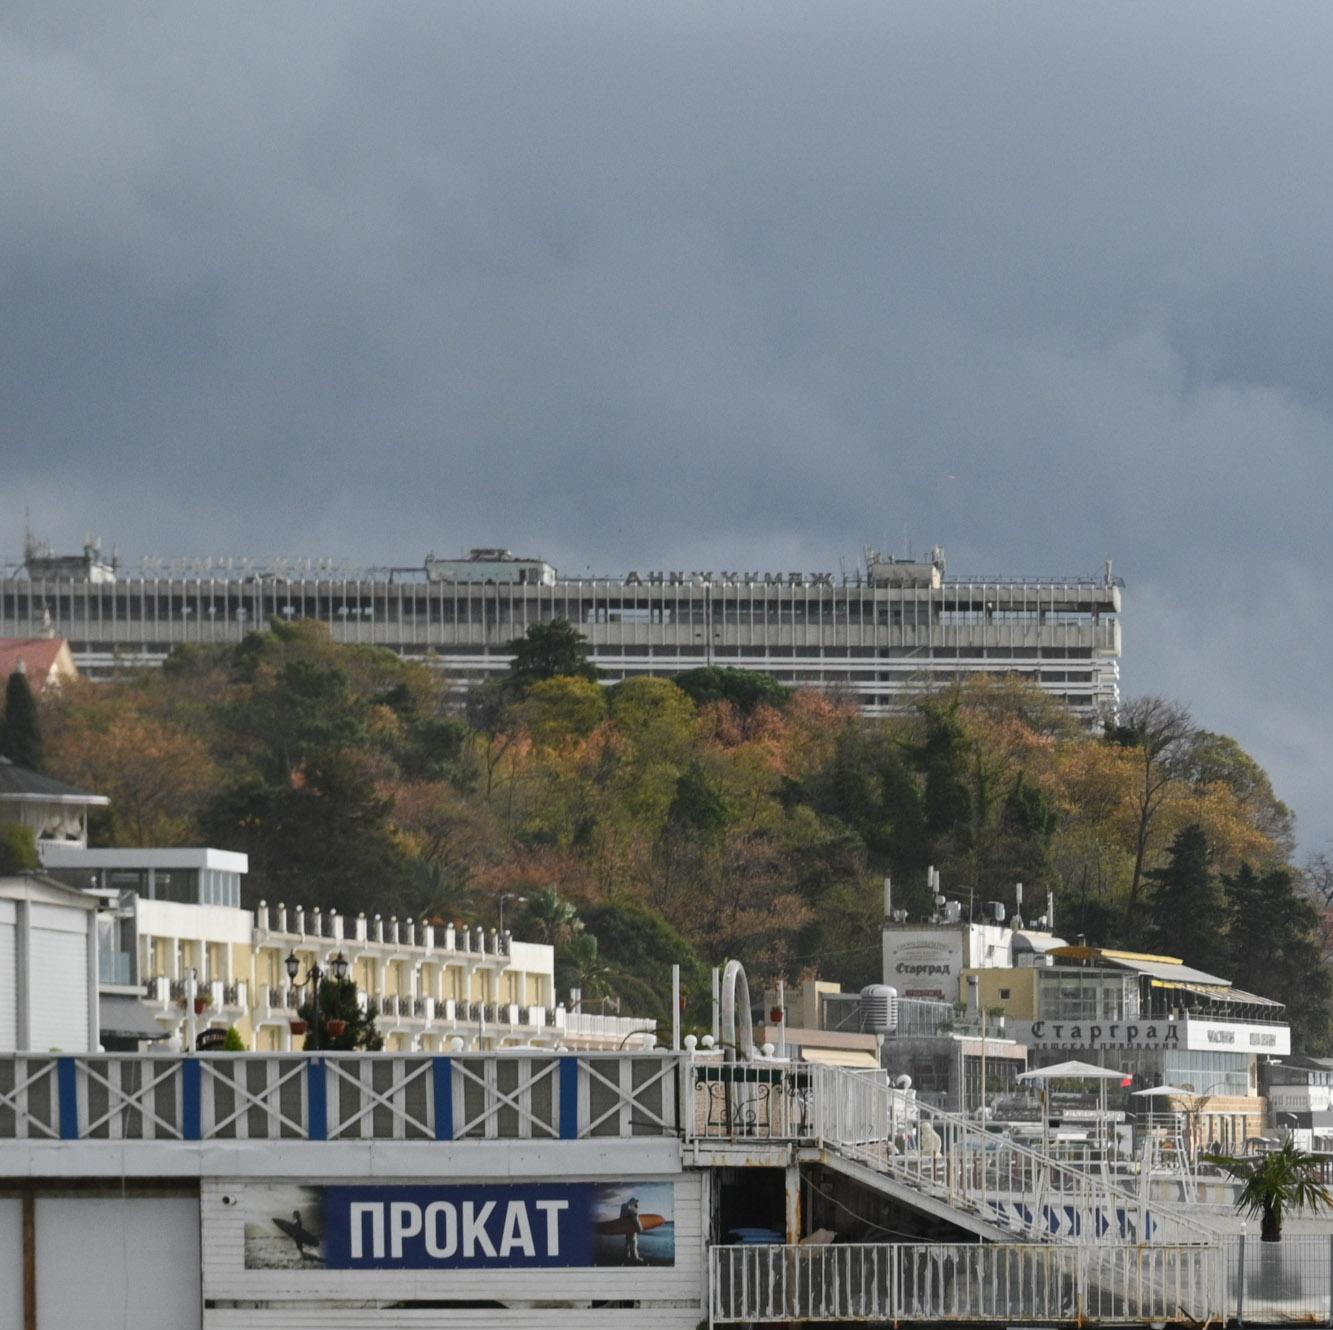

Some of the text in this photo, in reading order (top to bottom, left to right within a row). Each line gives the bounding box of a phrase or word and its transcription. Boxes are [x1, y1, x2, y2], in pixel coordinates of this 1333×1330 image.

[895, 962, 951, 976] Старград
[1031, 1021, 1179, 1042] Старград
[350, 1200, 569, 1258] ПРОКАТ
